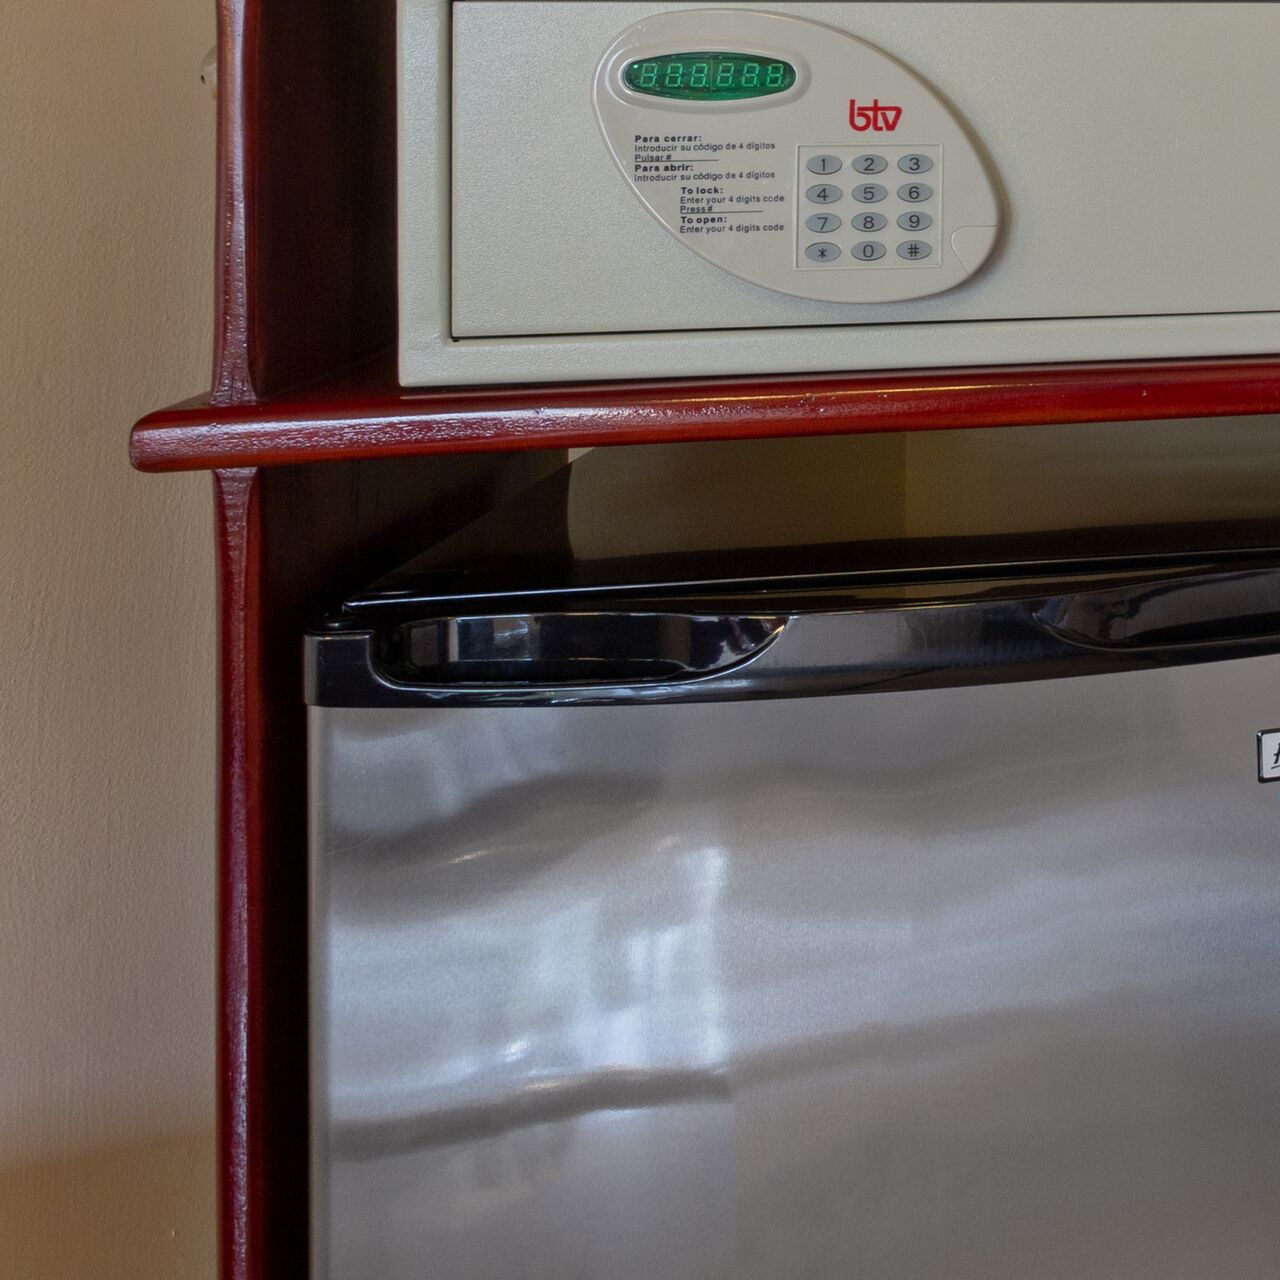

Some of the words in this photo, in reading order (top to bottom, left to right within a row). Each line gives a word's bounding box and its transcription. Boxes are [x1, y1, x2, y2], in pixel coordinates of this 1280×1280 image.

[849, 99, 903, 132] btv
[634, 135, 660, 143] Para
[664, 135, 702, 143] cerrar:
[634, 145, 678, 153] Introducir
[693, 143, 724, 152] código
[746, 142, 776, 151] dígitos
[634, 154, 664, 162] Pulsar
[634, 164, 660, 172] Para
[663, 164, 694, 172] abrir:
[864, 158, 875, 171] 2
[909, 157, 920, 171] 3
[634, 174, 677, 182] Introducir
[693, 172, 723, 181] código
[725, 172, 737, 180] de
[746, 171, 776, 180] dígitos
[696, 186, 724, 194] lock:
[817, 188, 829, 201] 4
[863, 187, 875, 200] 5
[908, 186, 920, 200] 6
[680, 196, 704, 204] Enter
[706, 197, 726, 205] your
[736, 195, 761, 204] digits
[680, 205, 706, 213] Press
[680, 216, 693, 224] To
[696, 216, 727, 225] open:
[817, 217, 828, 230] 7
[863, 216, 875, 230] 8
[909, 215, 920, 228] 9
[706, 226, 726, 234] your
[736, 224, 760, 233] digits
[863, 244, 874, 258] 0
[907, 243, 920, 257] #
